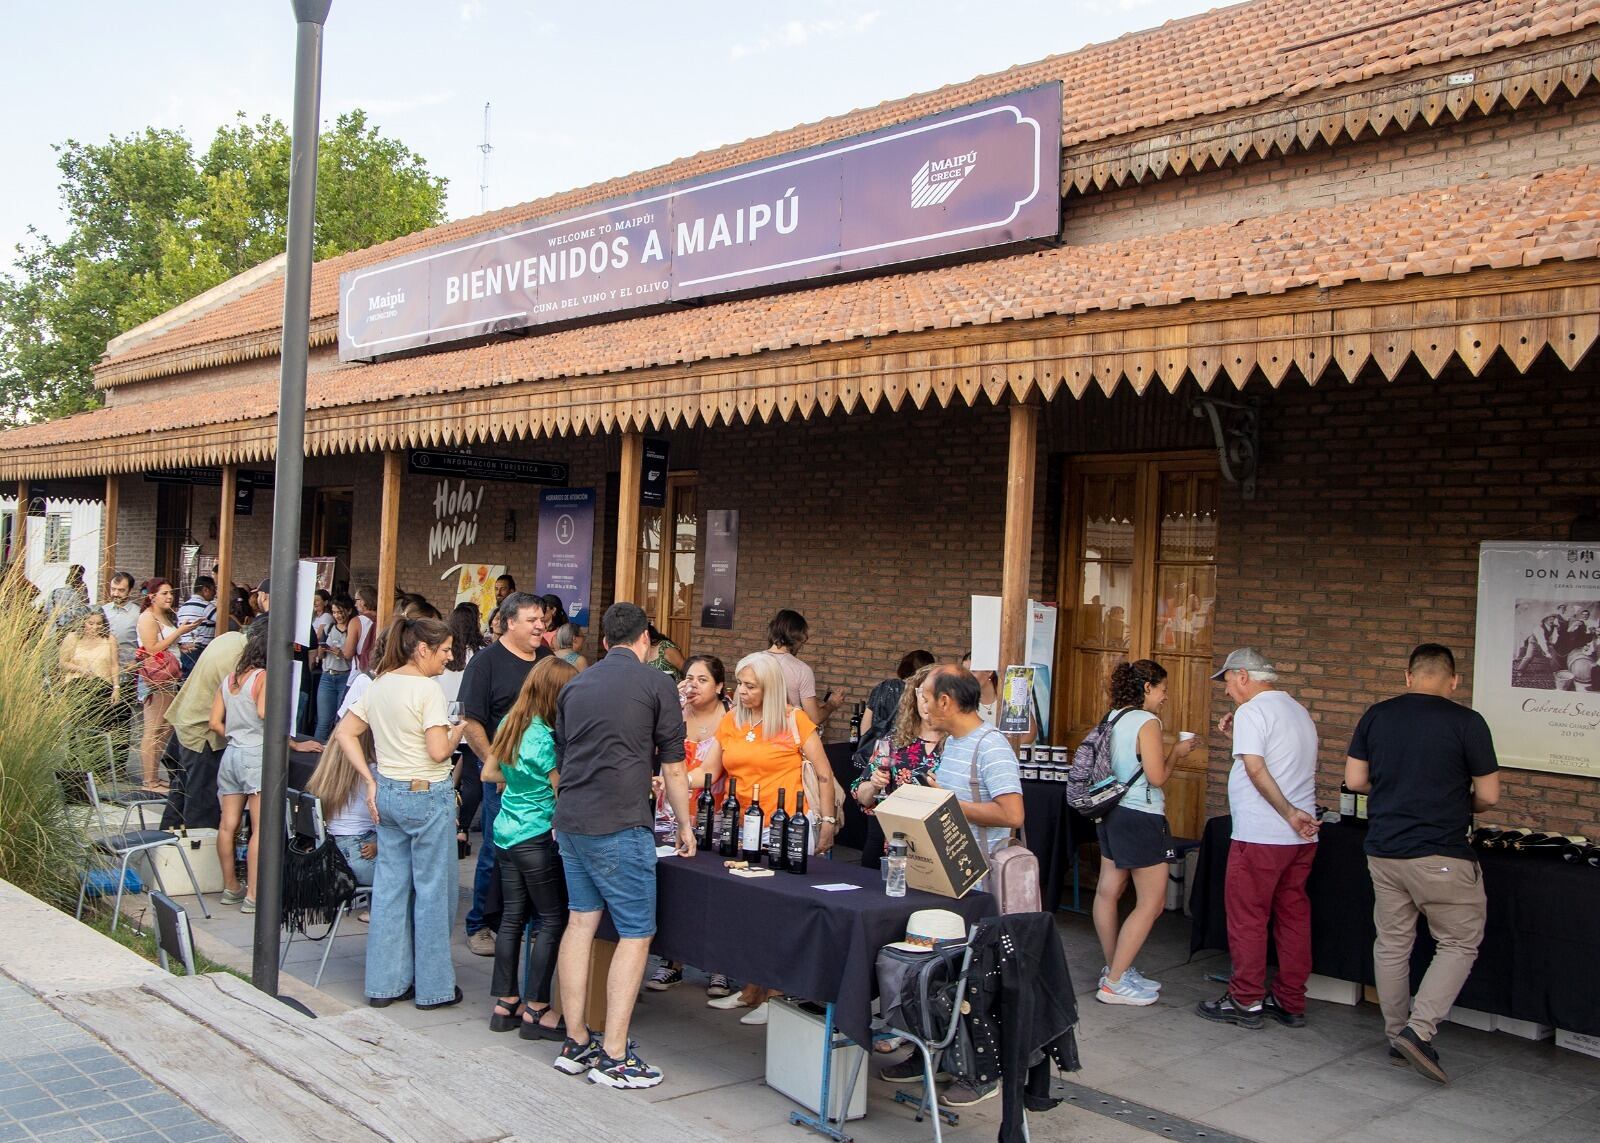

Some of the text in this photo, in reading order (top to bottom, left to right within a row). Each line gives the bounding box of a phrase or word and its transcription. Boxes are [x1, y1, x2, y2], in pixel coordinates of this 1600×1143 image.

[931, 150, 977, 172] MAIPÚ
[931, 169, 961, 182] CRECE
[548, 213, 654, 247] WELCOME TO MAIPÚ!
[446, 187, 798, 304] BIENVENIDOS A MAIPÚ
[368, 288, 405, 311] Maipú
[533, 280, 669, 314] CUNA DEL VINO Y EL OLIVO
[432, 480, 484, 520] Hola!
[428, 512, 478, 566] Maipú
[1525, 568, 1559, 578] DON
[1522, 698, 1571, 713] Cabernet
